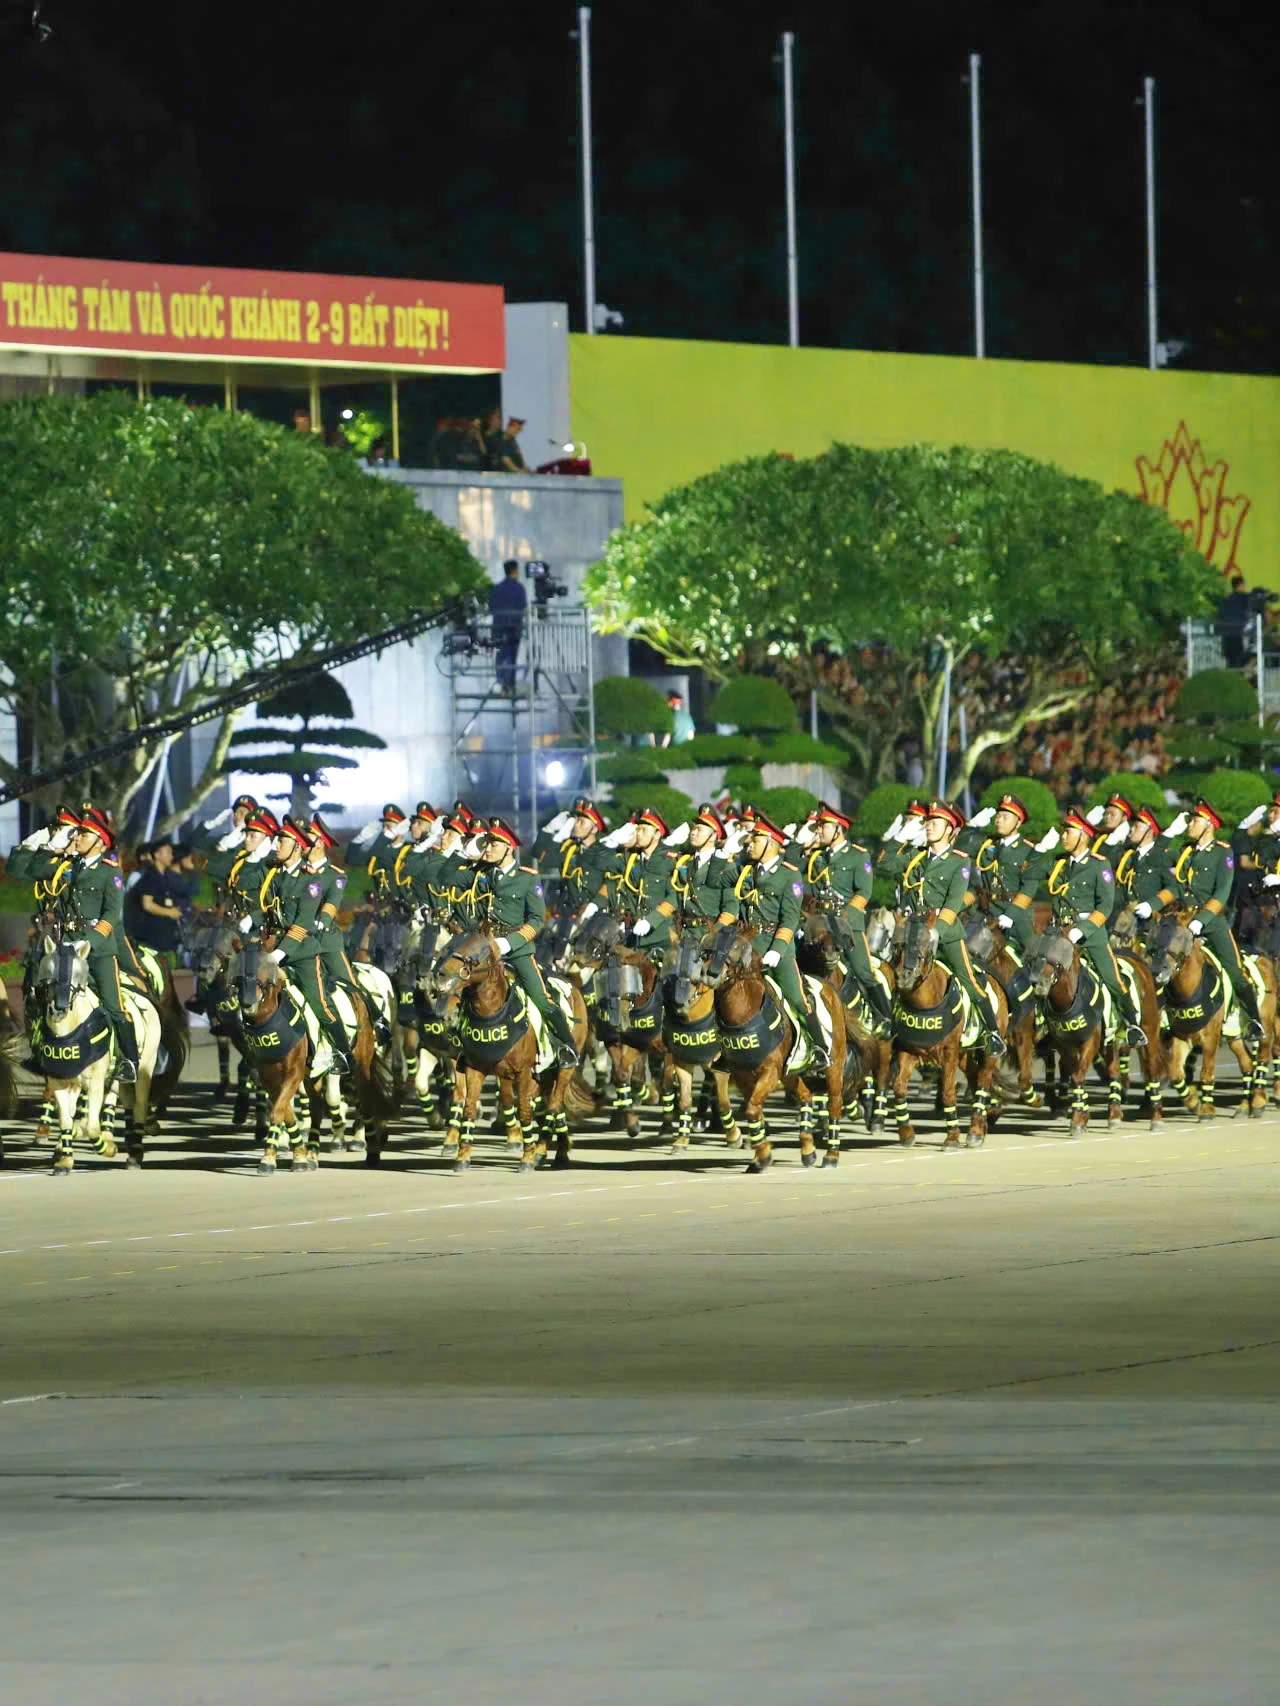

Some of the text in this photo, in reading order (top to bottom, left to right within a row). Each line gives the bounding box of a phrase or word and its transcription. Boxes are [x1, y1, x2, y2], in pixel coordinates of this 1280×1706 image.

[1, 275, 77, 332] THÁNG
[82, 279, 133, 334] TÁM
[135, 281, 167, 335] VÀ
[169, 280, 226, 341] QUỐC
[229, 289, 302, 343] KHÁNH
[305, 301, 345, 345] 2-9
[348, 291, 390, 348] BẤT
[393, 298, 451, 357] DIỆT!
[901, 1011, 943, 1030] POLICE
[673, 1028, 717, 1047] POLICE
